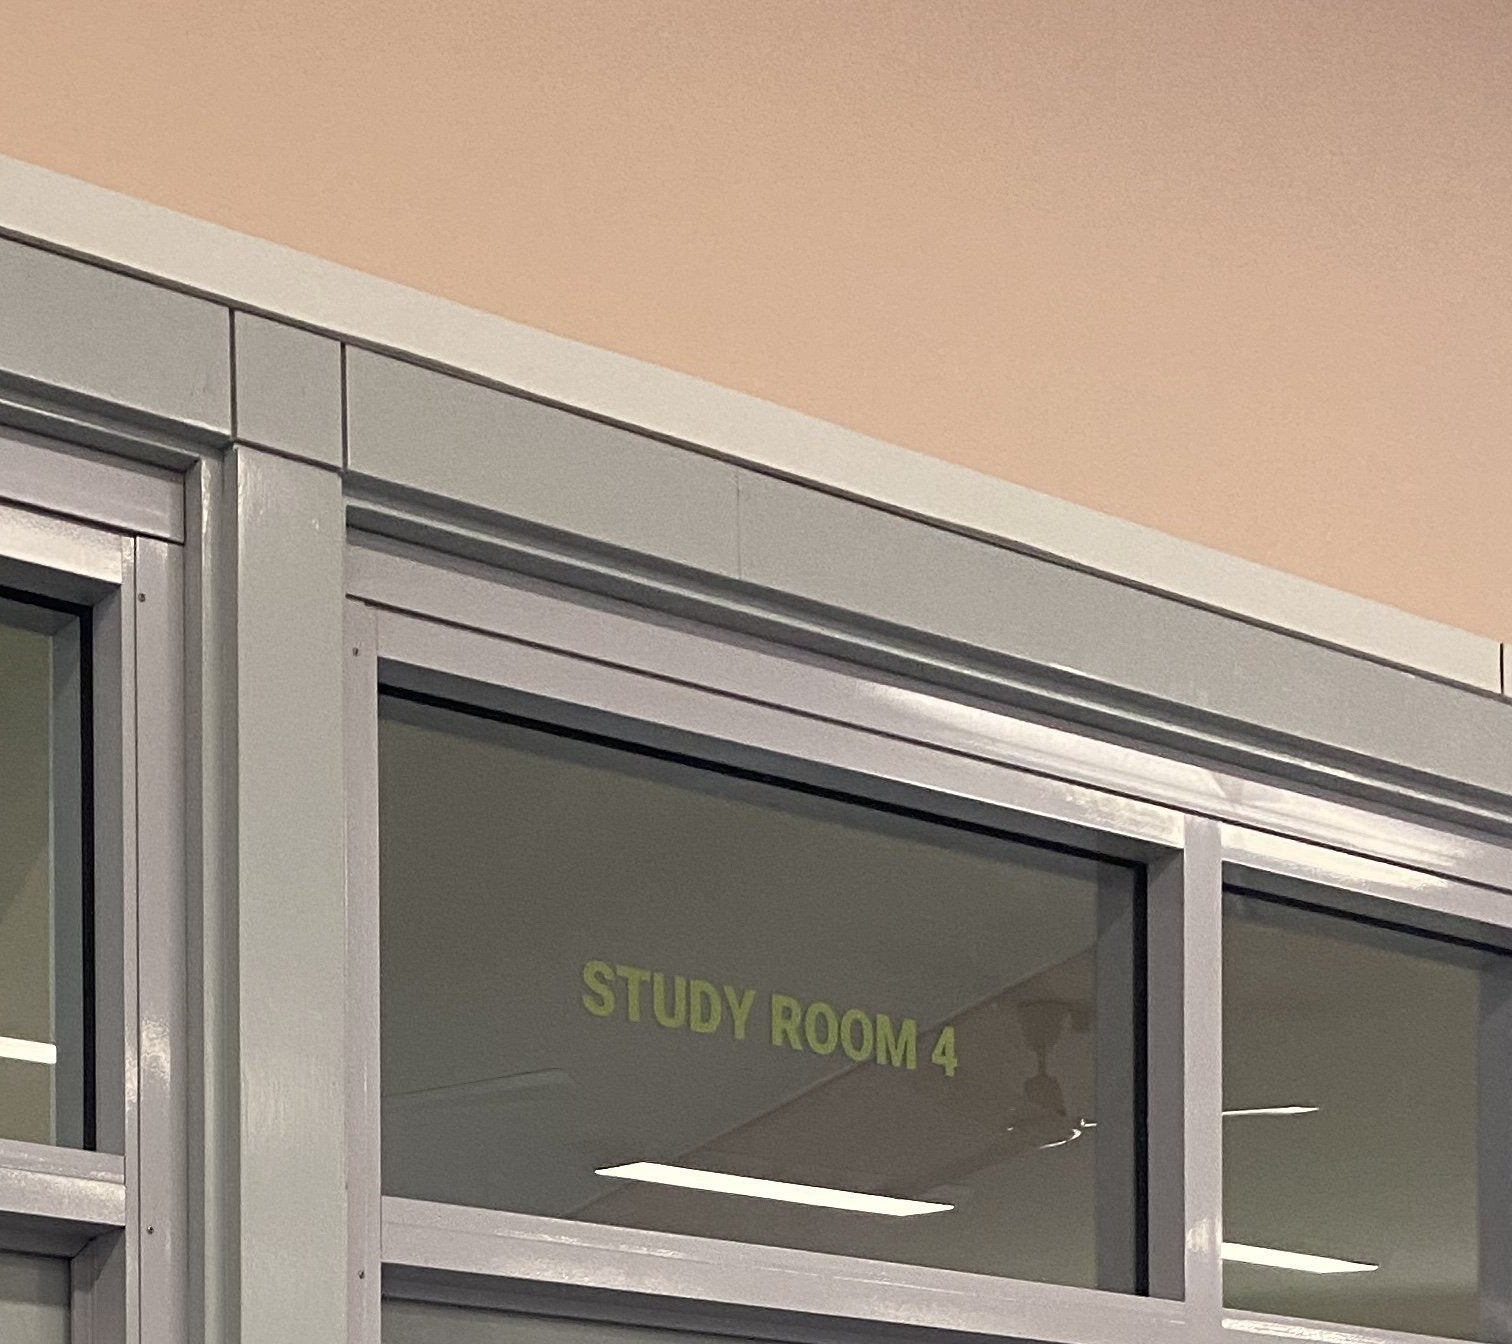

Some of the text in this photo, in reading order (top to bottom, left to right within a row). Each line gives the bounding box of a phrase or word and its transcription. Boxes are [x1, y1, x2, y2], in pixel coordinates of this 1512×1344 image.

[582, 960, 958, 1077] STUDY ROOM 4
